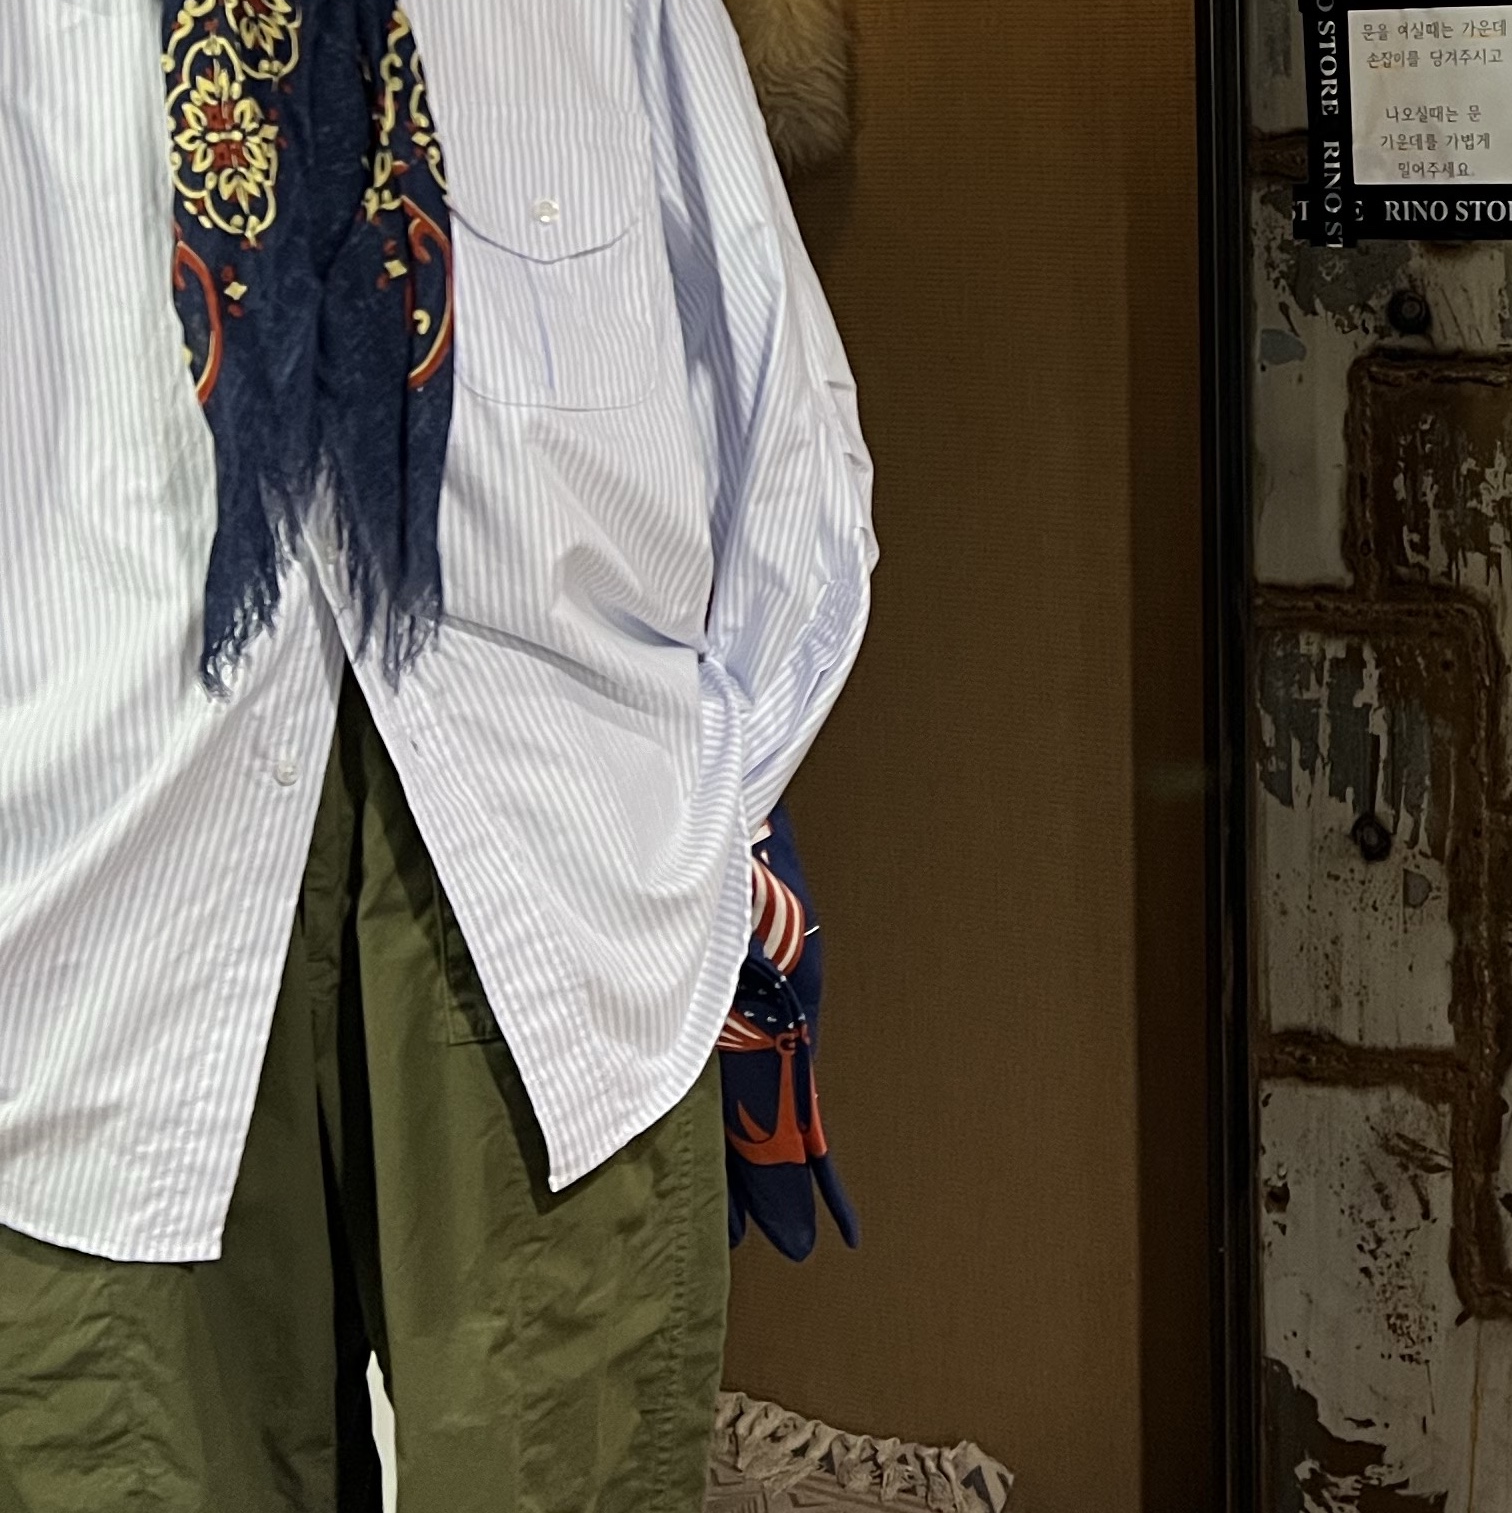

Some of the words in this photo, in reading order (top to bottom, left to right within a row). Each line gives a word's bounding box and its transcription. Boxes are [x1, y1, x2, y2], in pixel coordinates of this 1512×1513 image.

[1361, 23, 1389, 42] 문을
[1462, 19, 1507, 38] 가운데
[1317, 20, 1339, 116] STORE
[1366, 50, 1420, 69] 손잡이를
[1430, 48, 1503, 68] 당겨주시고
[1385, 105, 1459, 123] 나오실때는
[1466, 104, 1482, 123] 문
[1323, 141, 1342, 213] RINO
[1385, 200, 1449, 222] RINO
